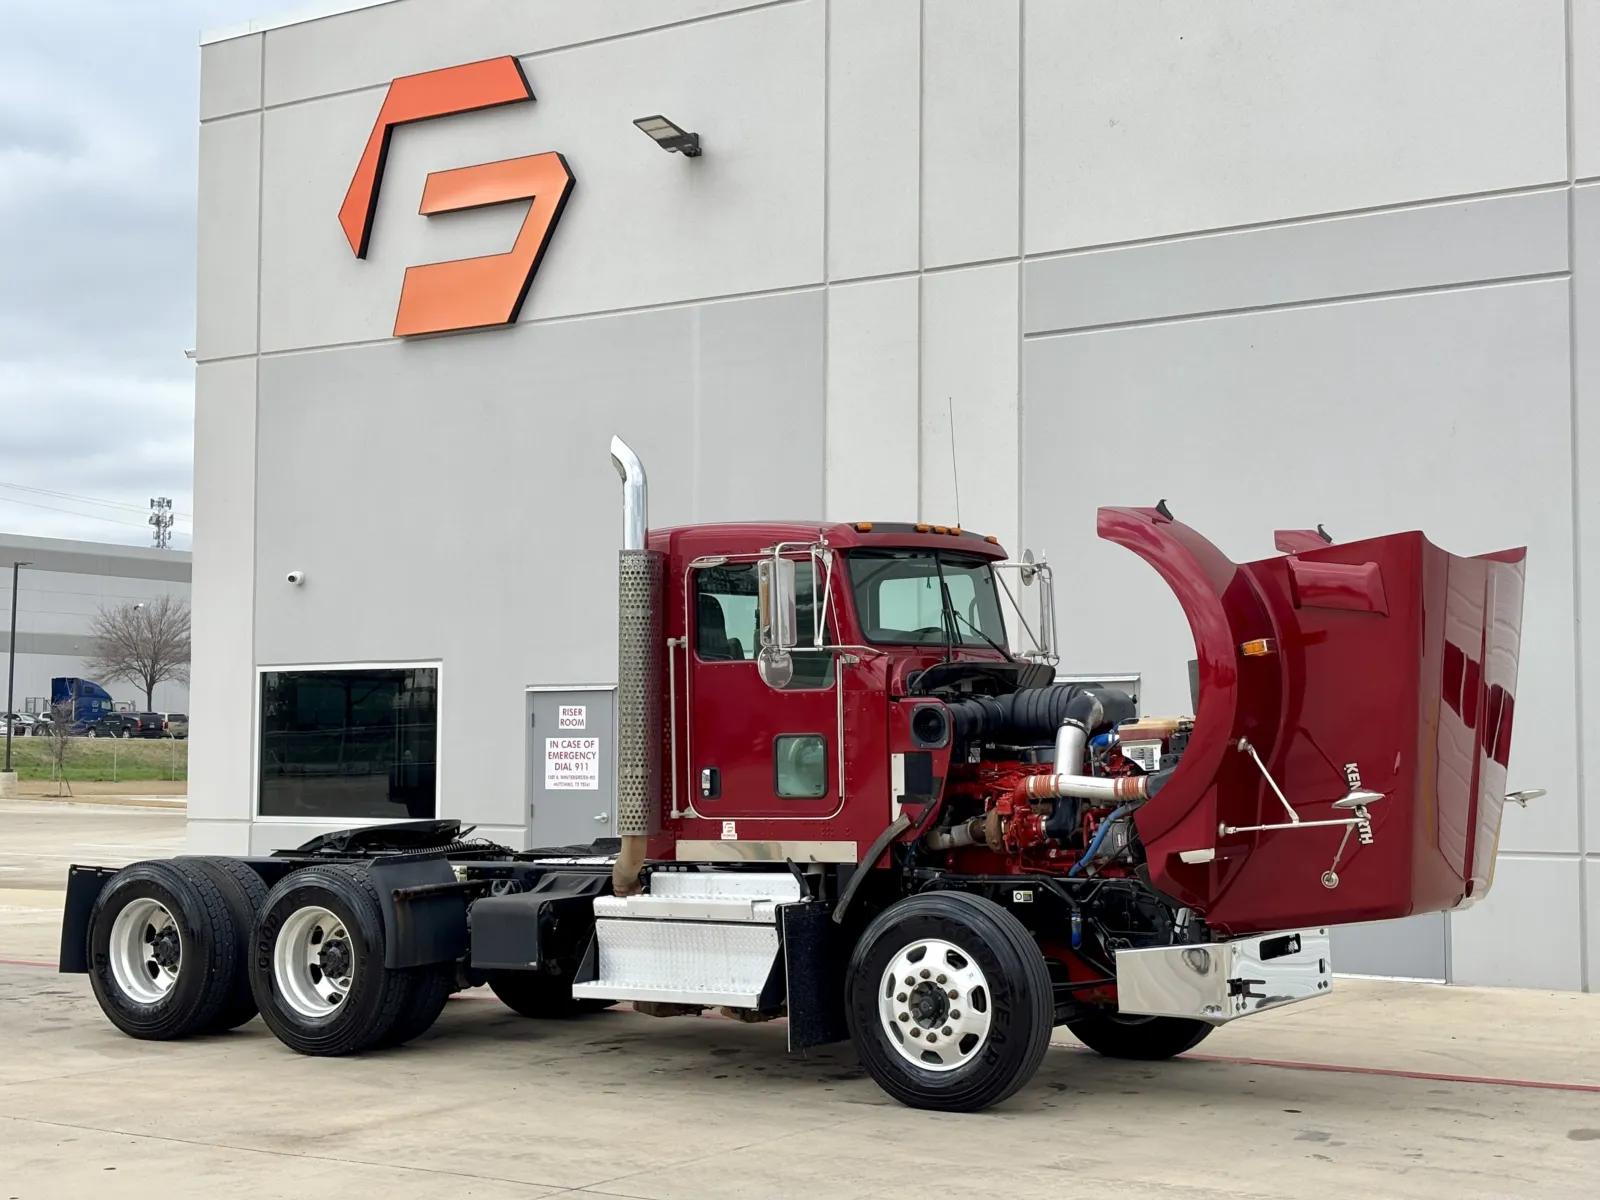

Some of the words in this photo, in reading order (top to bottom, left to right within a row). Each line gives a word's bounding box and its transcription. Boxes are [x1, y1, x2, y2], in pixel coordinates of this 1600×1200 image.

[562, 708, 582, 716] RISER
[560, 718, 584, 726] ROOM
[550, 740, 559, 748] IN
[561, 740, 581, 748] CASE
[583, 740, 595, 748] OF
[548, 751, 596, 760] EMERGENCY
[554, 762, 573, 771] DIAL
[575, 762, 588, 771] 911
